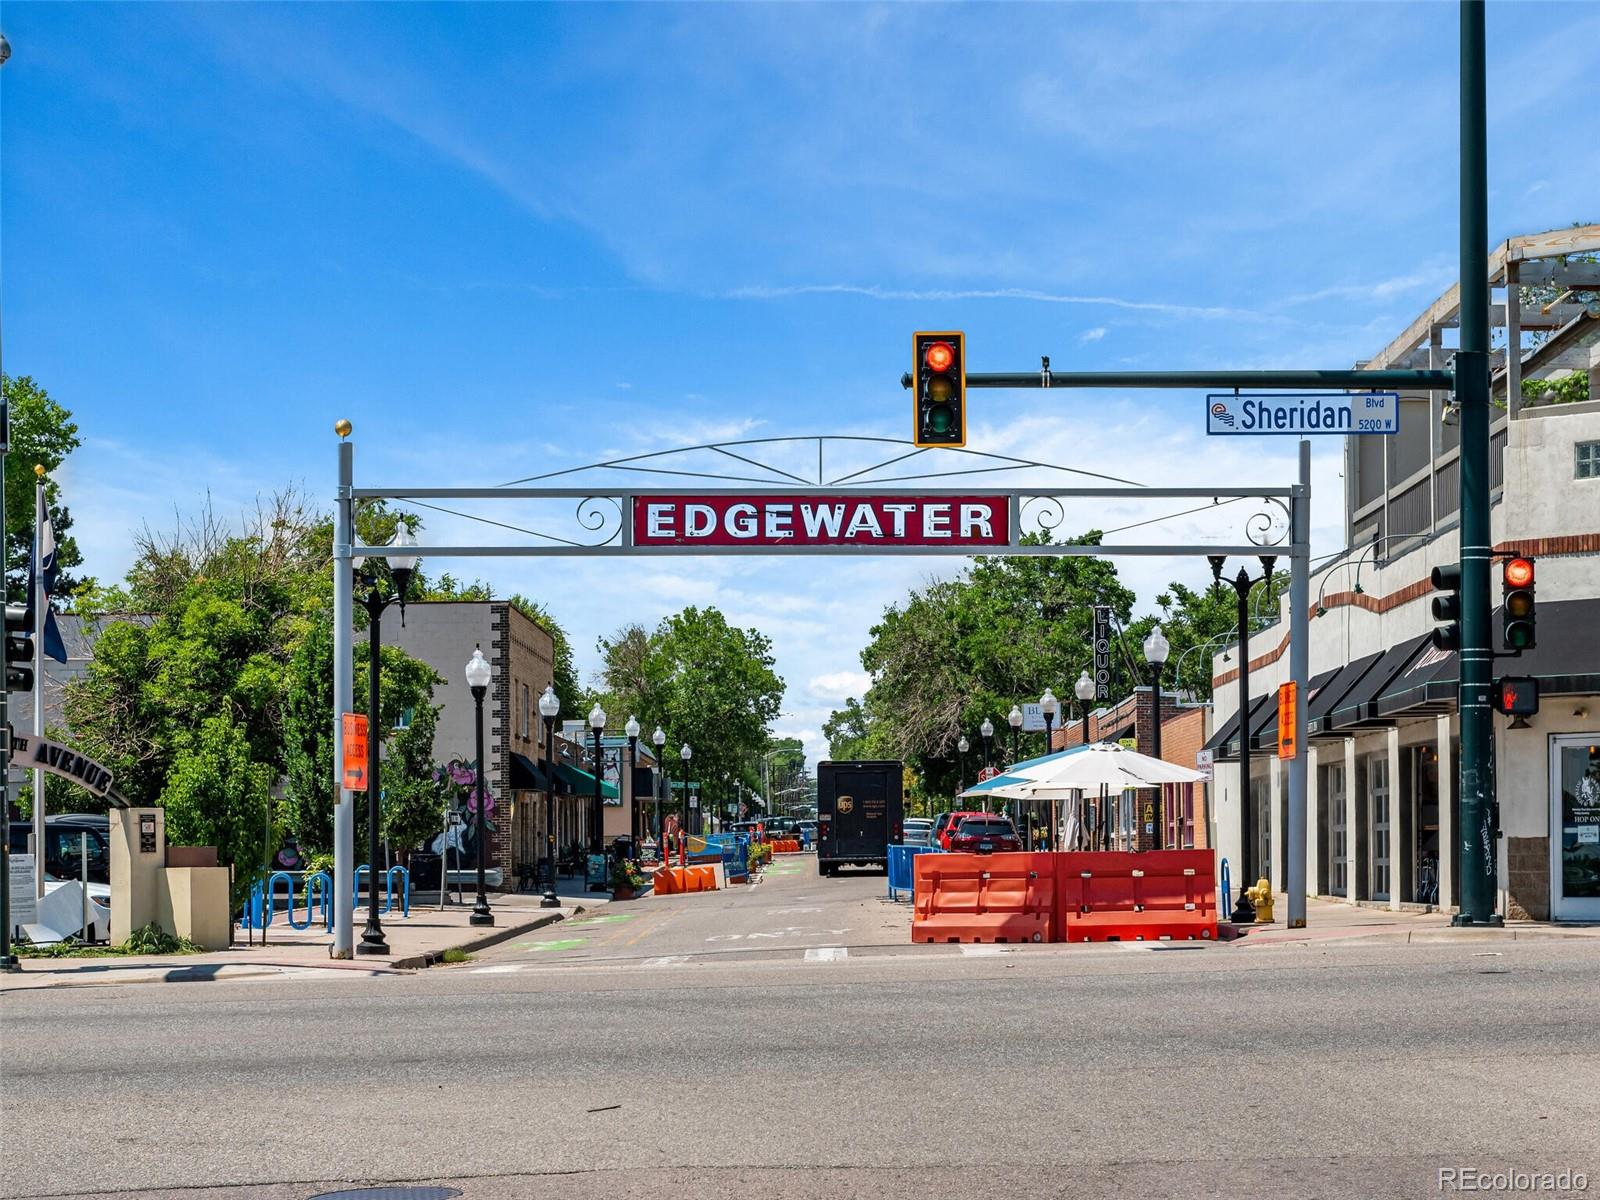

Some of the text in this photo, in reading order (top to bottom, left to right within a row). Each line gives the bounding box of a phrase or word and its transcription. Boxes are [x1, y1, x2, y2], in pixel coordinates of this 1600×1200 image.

[1365, 398, 1384, 408] Blvd
[1242, 400, 1351, 429] Sheridan
[1358, 419, 1391, 430] 5200 W
[646, 503, 993, 538] EDGEWATER
[1095, 610, 1110, 698] LIQUOR
[346, 744, 364, 758] ACCESS
[34, 742, 113, 795] AVENUE
[838, 801, 853, 811] ups
